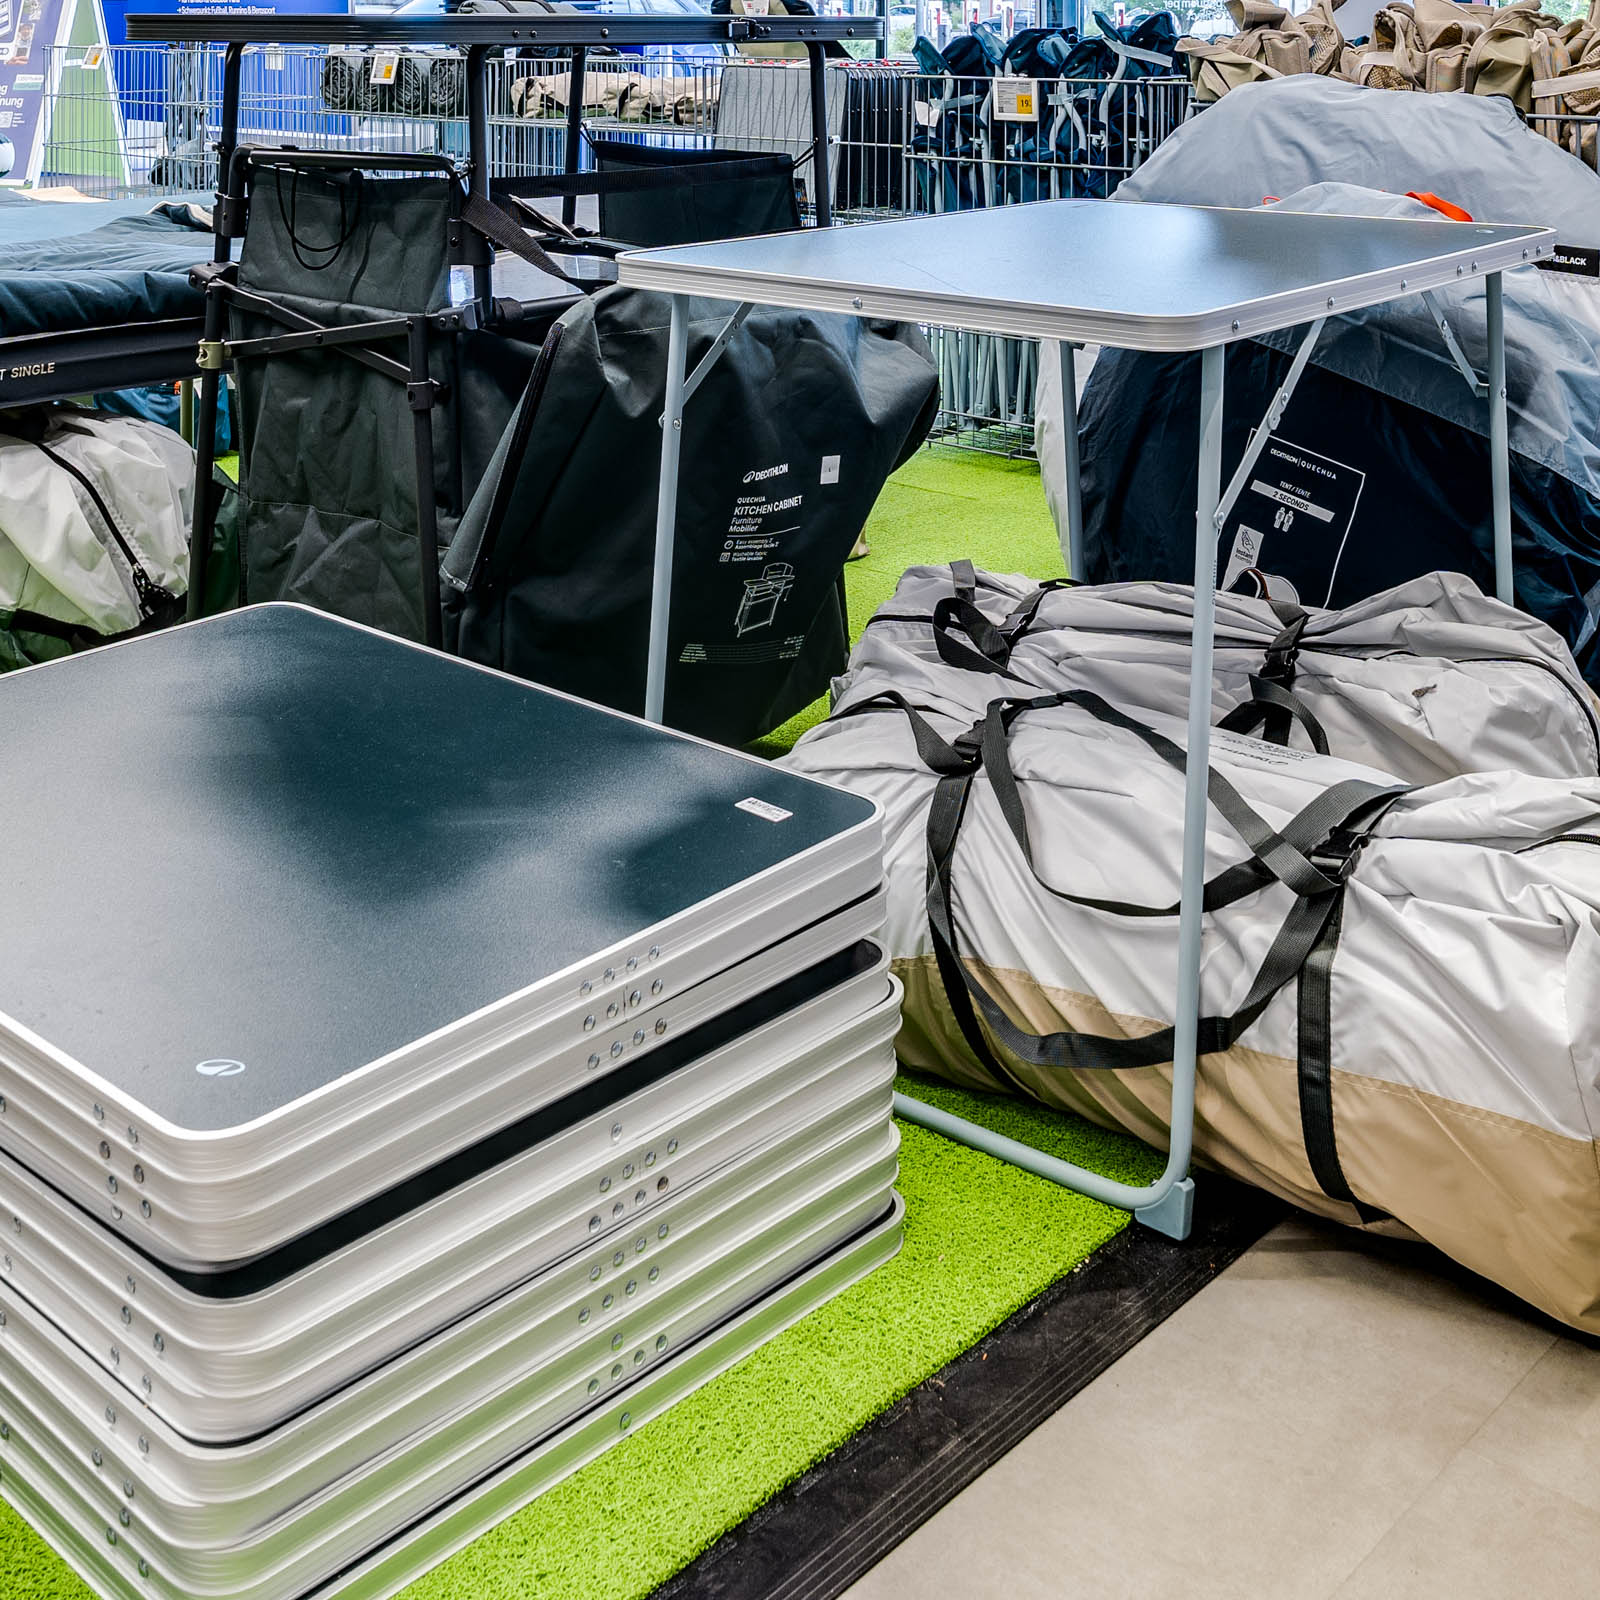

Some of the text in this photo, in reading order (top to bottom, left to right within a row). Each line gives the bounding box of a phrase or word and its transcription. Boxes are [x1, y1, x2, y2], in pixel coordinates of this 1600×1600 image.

[1552, 255, 1587, 266] &BLACK
[10, 362, 56, 379] SINGLE
[754, 463, 789, 481] DECATHLON
[1270, 448, 1337, 480] DECATHLON QUECHUA
[734, 495, 803, 516] KITCHEN CABINET
[737, 495, 766, 505] QUECHUA
[1272, 490, 1310, 512] 2 SECONDS
[729, 525, 758, 533] Mobilier
[731, 517, 762, 525] Furniture
